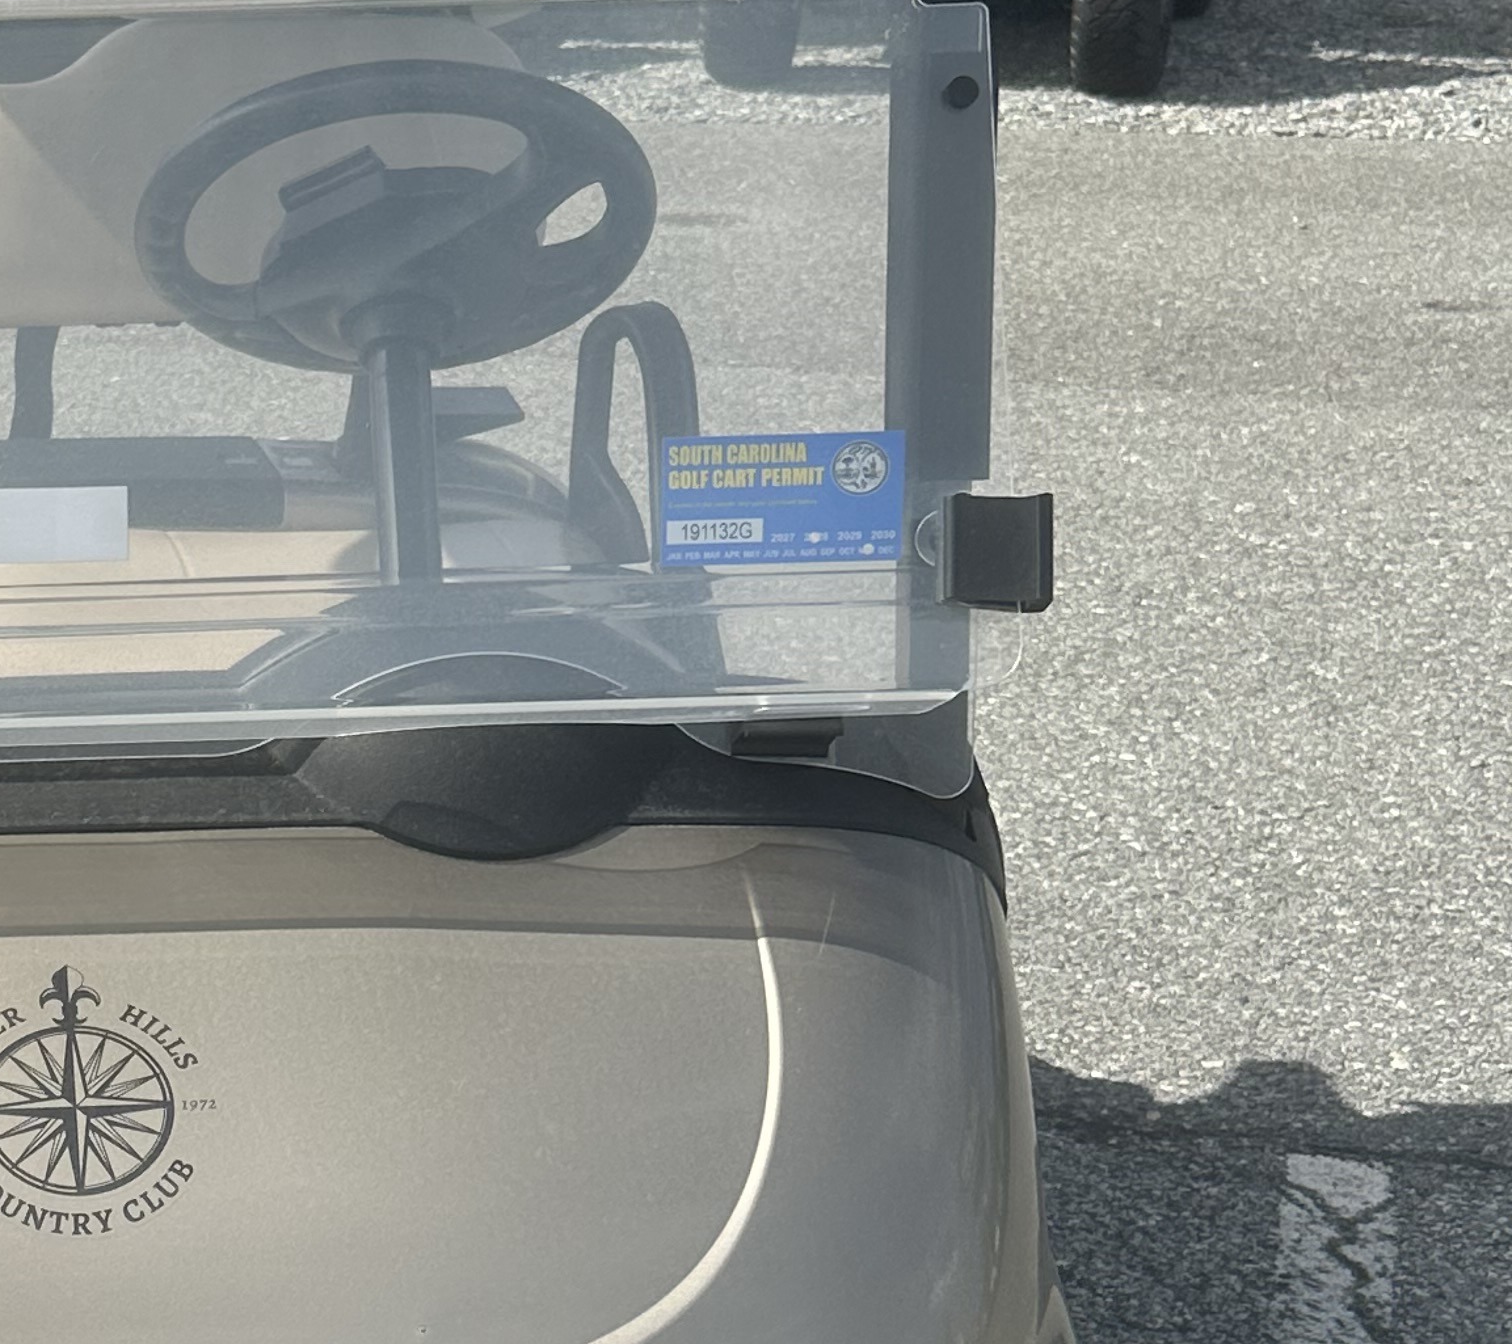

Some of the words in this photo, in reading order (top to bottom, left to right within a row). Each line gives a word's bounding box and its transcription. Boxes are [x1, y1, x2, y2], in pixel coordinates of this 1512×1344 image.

[669, 445, 723, 466] SOUTH
[727, 442, 807, 465] CAROLINA
[669, 470, 709, 490] GOLF
[712, 468, 757, 489] CART
[761, 466, 825, 487] PERMIT
[681, 521, 753, 541] 191132G
[870, 529, 896, 540] 2030
[838, 546, 855, 555] OCT
[877, 546, 895, 554] DEC
[119, 1004, 199, 1070] HILLS
[181, 1099, 217, 1111] 1972
[123, 1159, 194, 1223] CLUB
